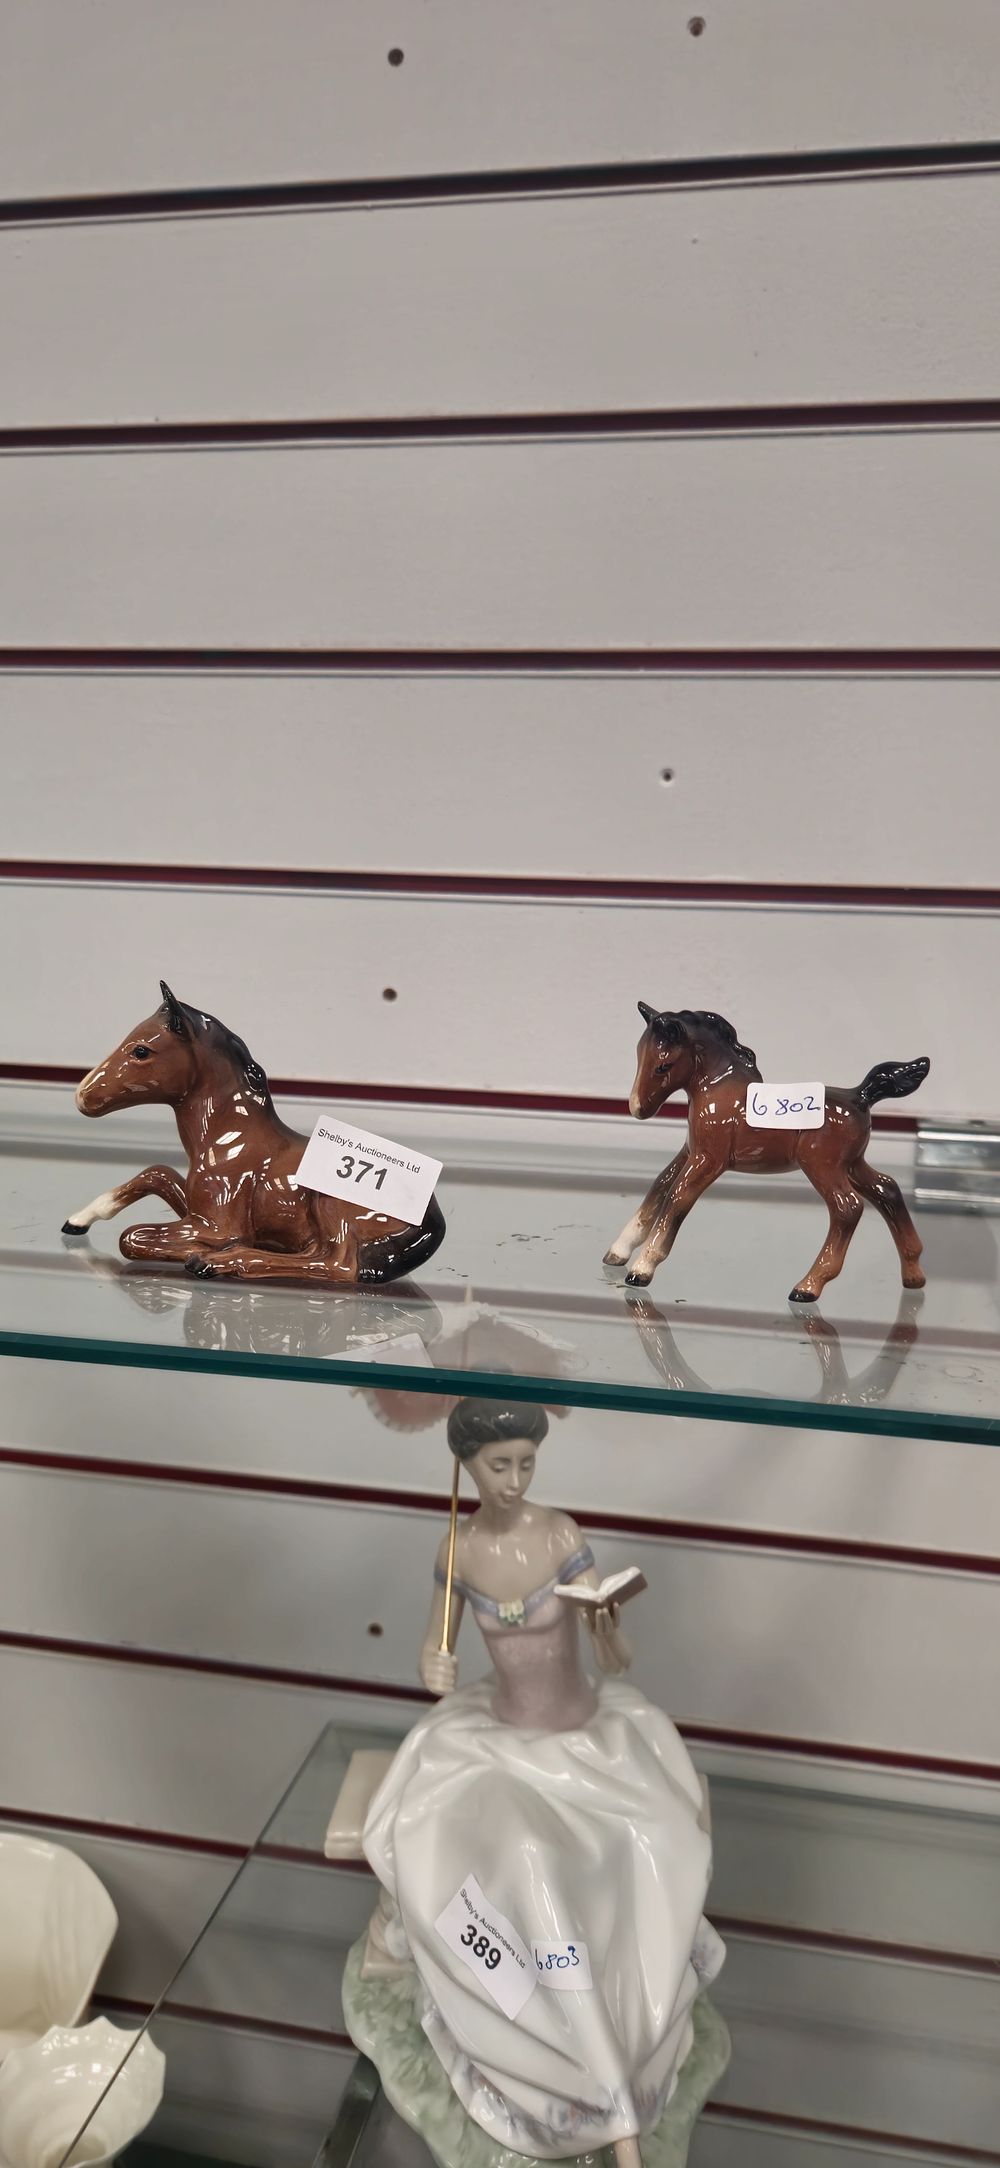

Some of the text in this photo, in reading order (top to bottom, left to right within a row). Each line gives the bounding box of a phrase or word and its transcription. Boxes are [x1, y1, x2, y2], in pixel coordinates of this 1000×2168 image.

[317, 1128, 421, 1174] Shelby's Auctioneers Ltd
[336, 1155, 388, 1191] 371
[460, 1924, 502, 1970] 389
[479, 1917, 516, 1957] Auctioneers
[515, 1954, 526, 1969] Ltd
[534, 1945, 580, 1970] 6803
